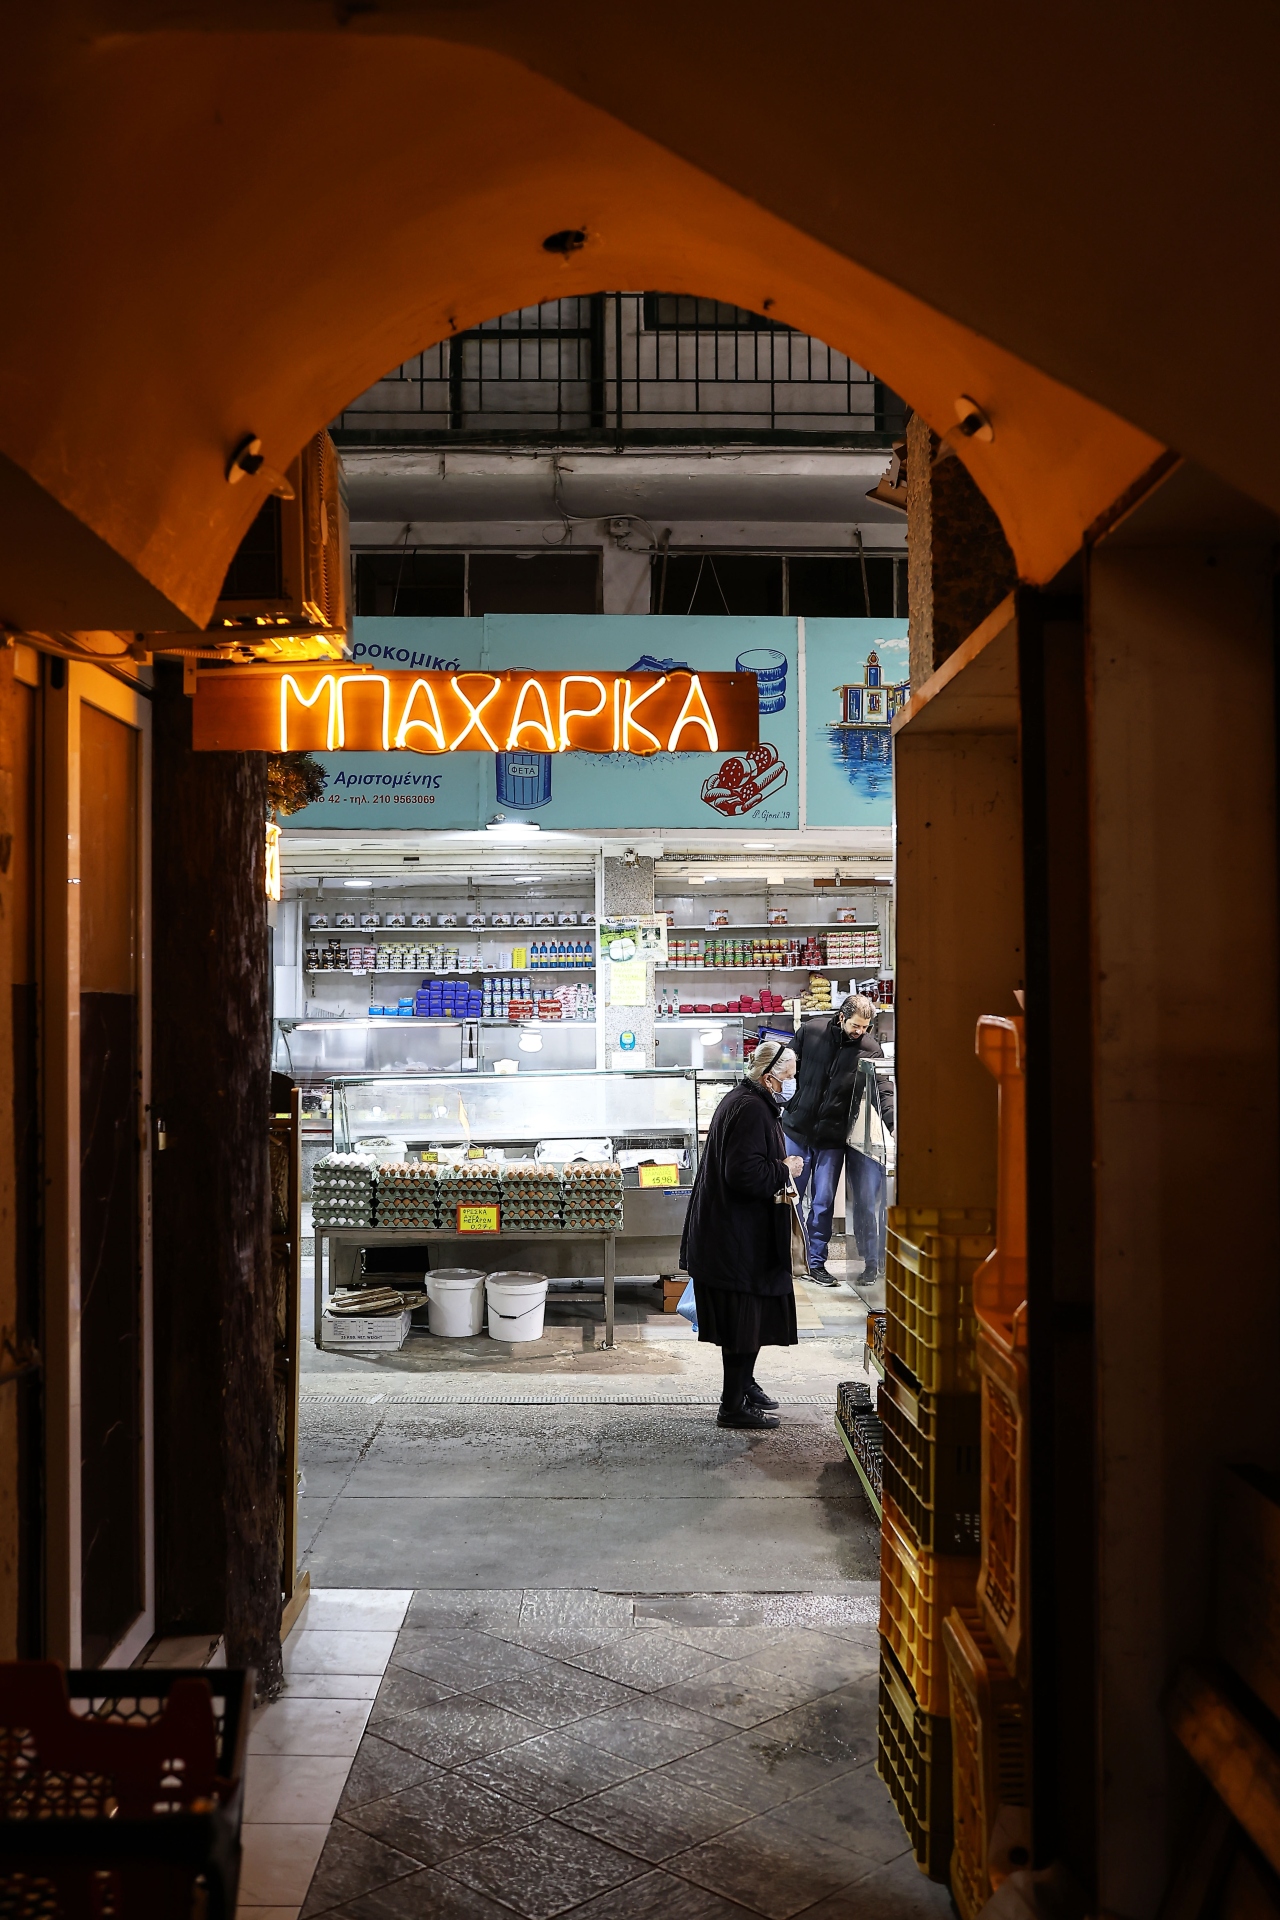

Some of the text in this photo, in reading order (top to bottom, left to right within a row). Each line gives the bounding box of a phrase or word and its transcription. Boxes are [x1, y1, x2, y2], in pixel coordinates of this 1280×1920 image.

[280, 674, 719, 753] ΜΠΑΧΑΡΙΚΑ
[511, 766, 536, 775] ΦΕΤΑ
[333, 771, 443, 788] Αριστομένης
[328, 795, 341, 804] 42
[350, 795, 370, 805] τηλ.
[373, 795, 391, 804] 210
[393, 795, 436, 804] 9563069
